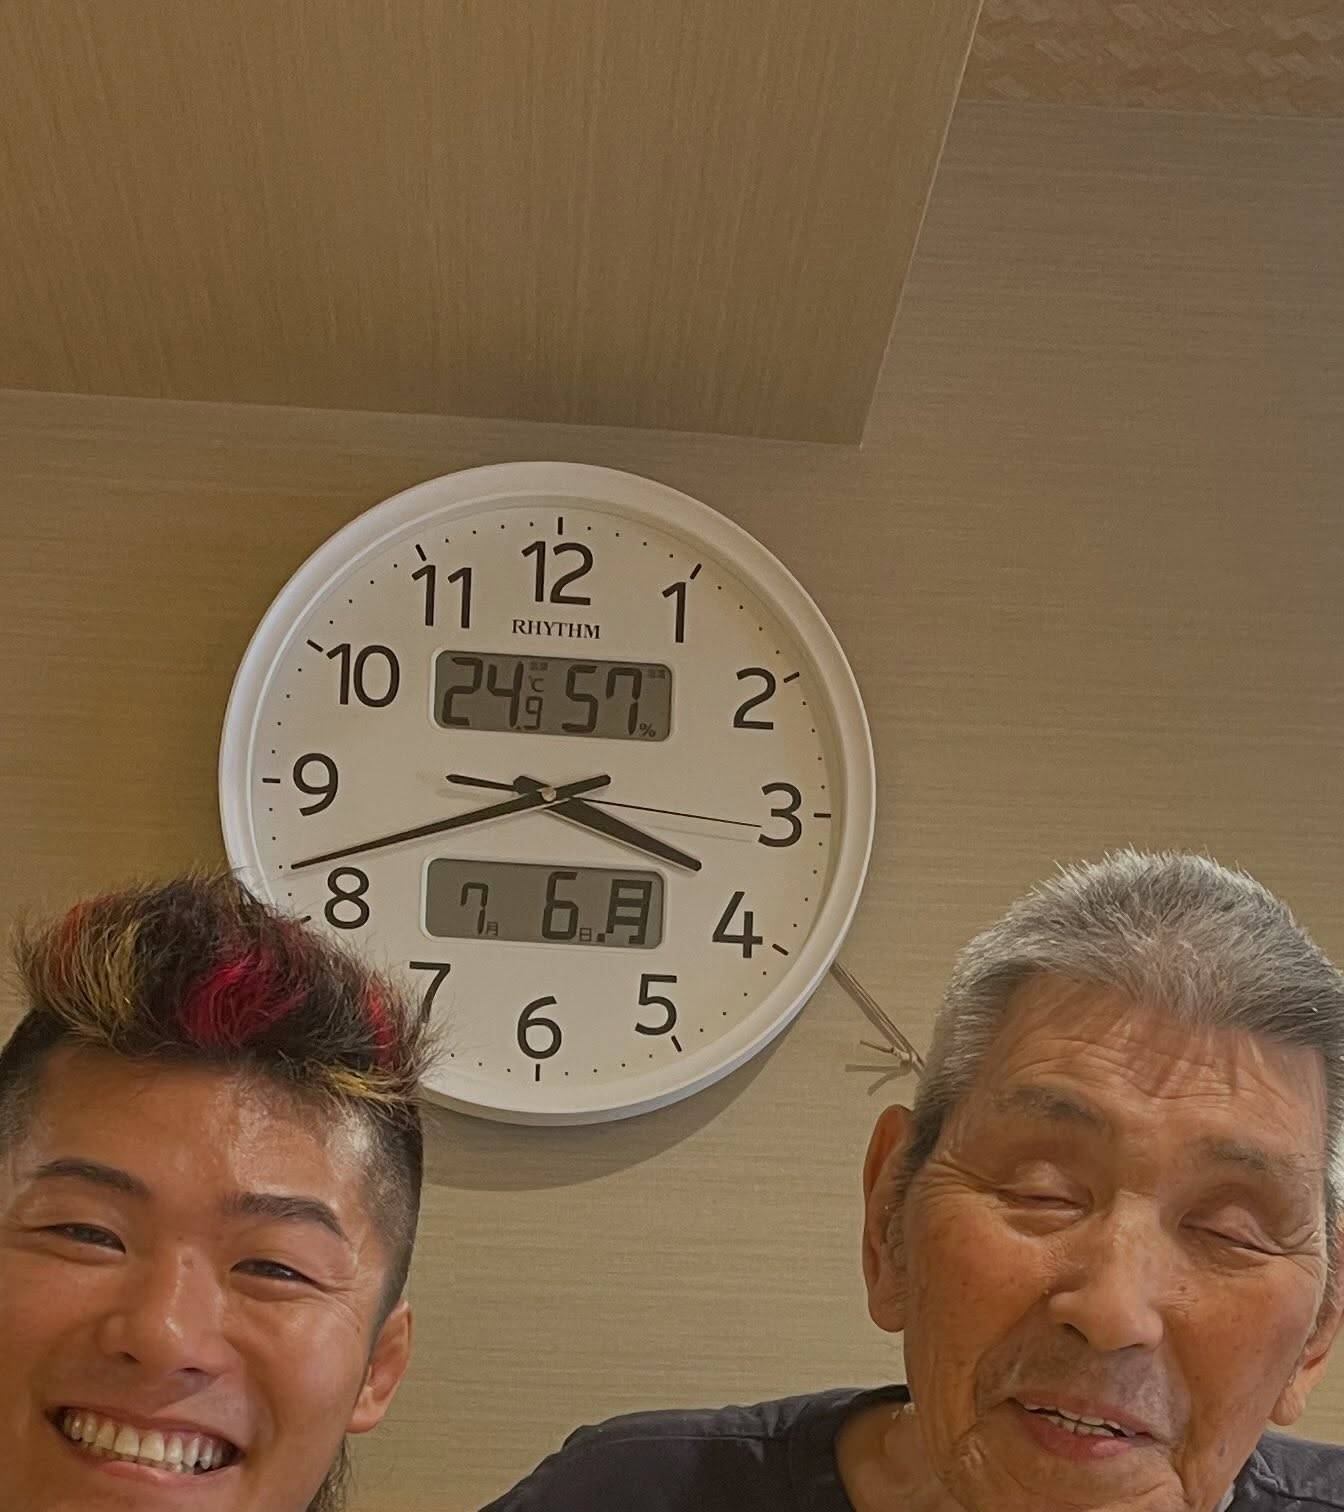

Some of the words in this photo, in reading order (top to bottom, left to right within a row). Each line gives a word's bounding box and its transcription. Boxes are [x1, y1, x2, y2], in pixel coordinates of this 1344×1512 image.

[411, 564, 473, 629] 11
[521, 540, 594, 606] 12
[512, 619, 601, 639] RHYTHM
[661, 581, 688, 644] 1
[326, 643, 401, 708] 10
[732, 667, 777, 731] 2
[292, 752, 339, 817] 9
[757, 782, 803, 848] 3
[324, 866, 371, 930] 8
[711, 891, 764, 960] 4
[409, 961, 452, 1024] 7
[634, 973, 678, 1037] 5
[516, 995, 563, 1060] 6
